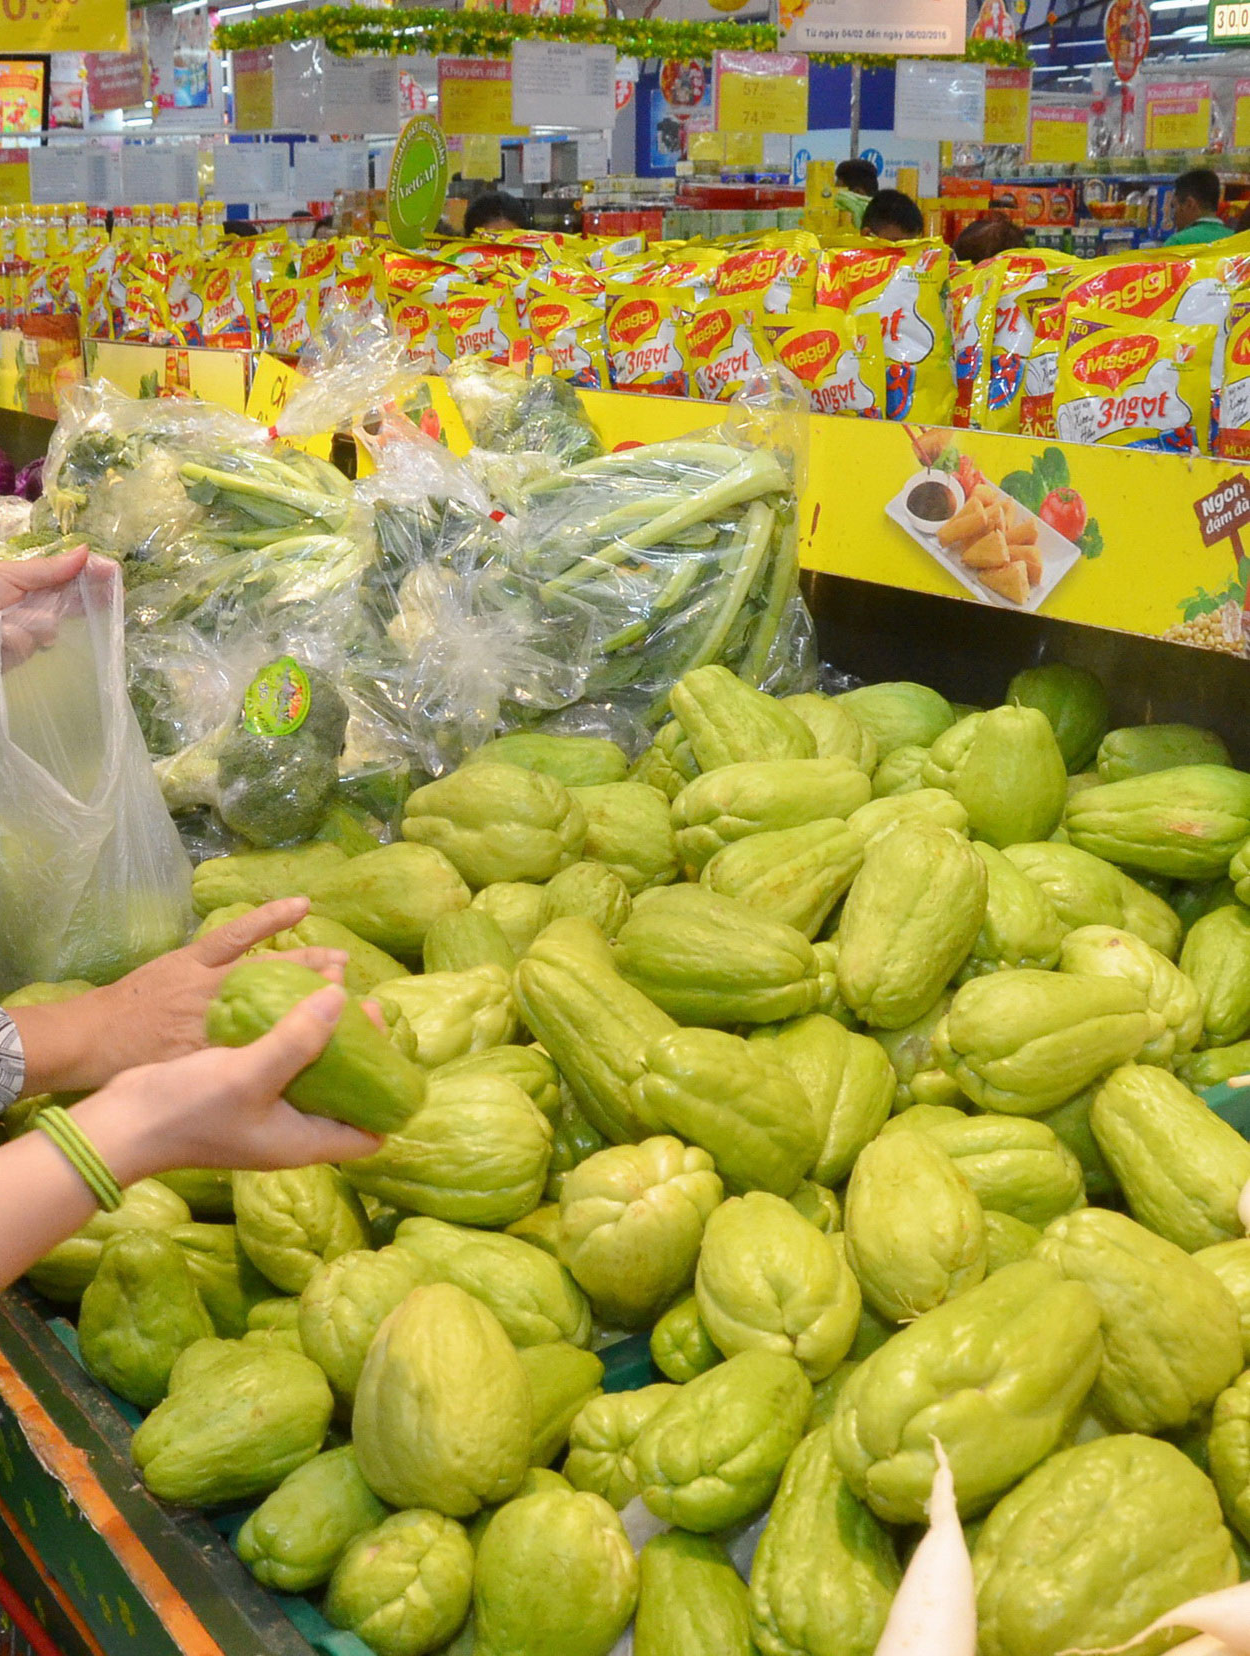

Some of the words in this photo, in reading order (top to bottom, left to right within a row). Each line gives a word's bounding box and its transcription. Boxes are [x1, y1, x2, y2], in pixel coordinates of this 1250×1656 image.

[818, 29, 839, 39] ngày
[883, 30, 903, 40] ngày
[614, 305, 654, 334] Maggi
[784, 336, 830, 370] Maggi
[1086, 343, 1151, 375] Maggi
[1202, 481, 1245, 517] Ngon
[1206, 510, 1233, 535] đậm
